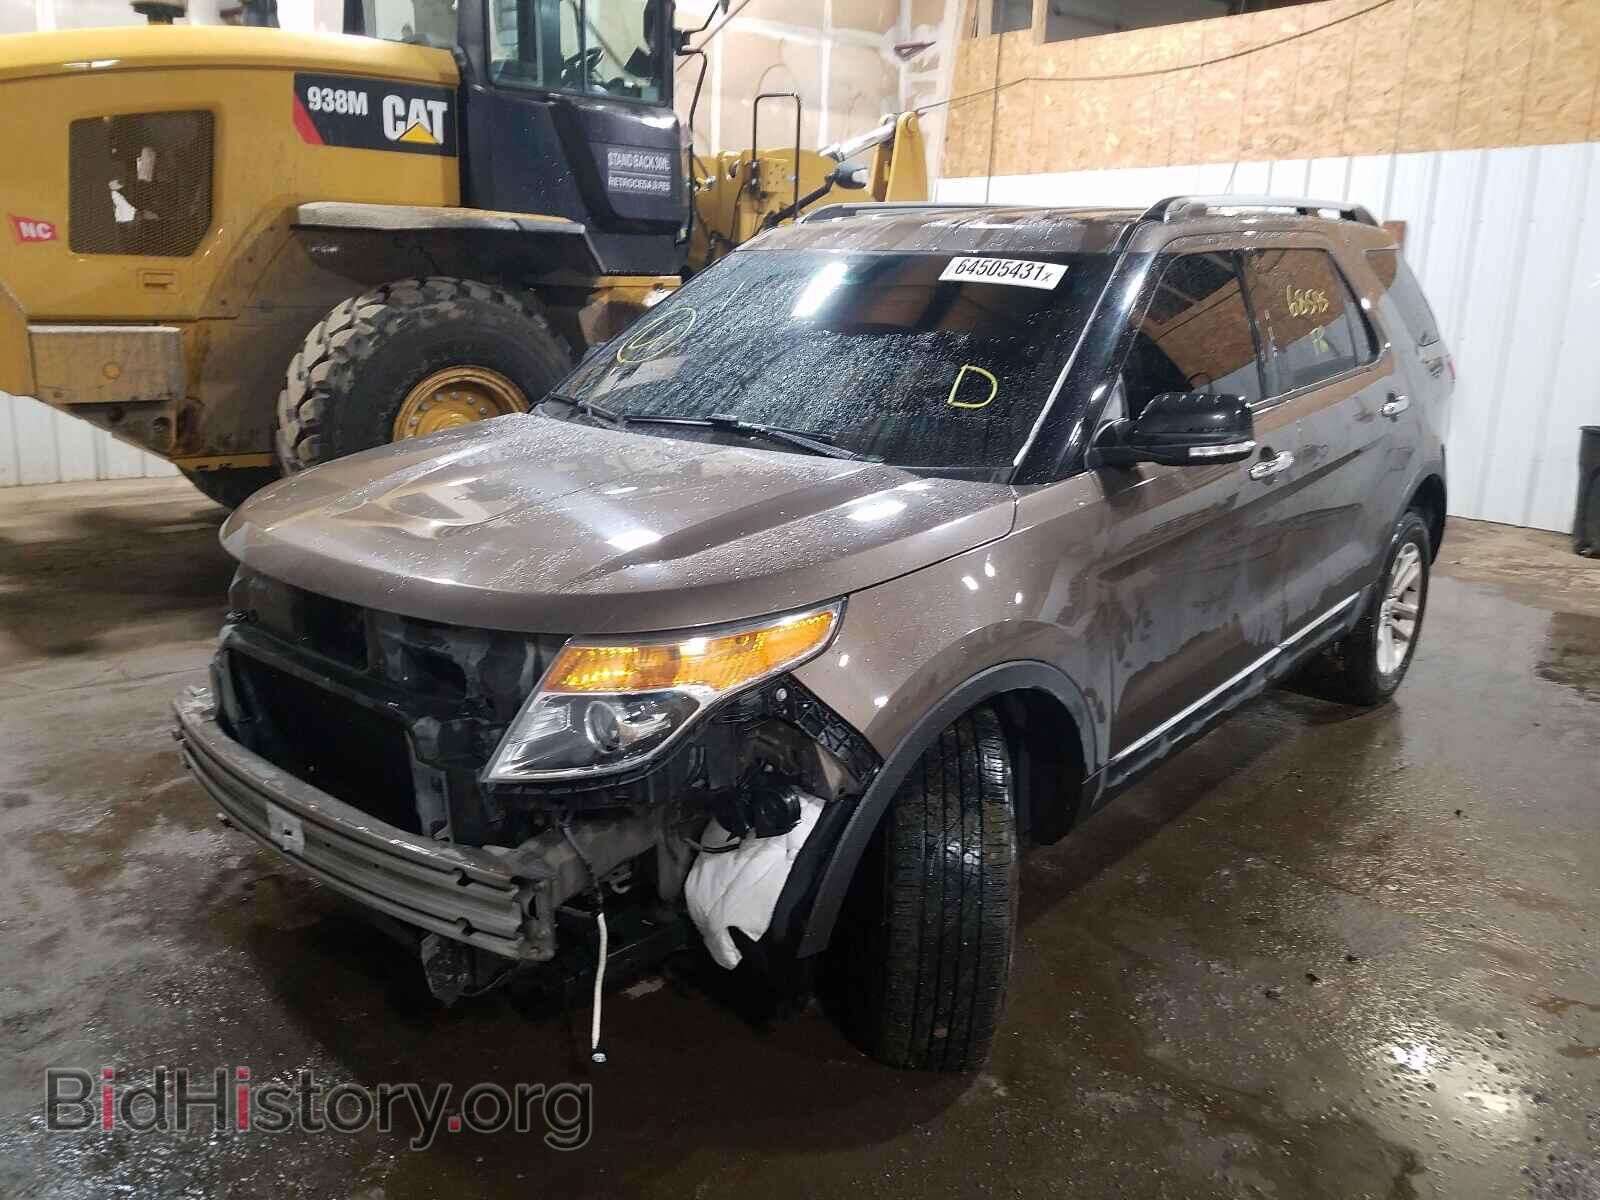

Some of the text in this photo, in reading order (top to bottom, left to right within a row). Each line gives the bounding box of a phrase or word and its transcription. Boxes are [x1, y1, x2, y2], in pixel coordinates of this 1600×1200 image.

[307, 86, 368, 116] 938M
[382, 94, 448, 145] CAT
[947, 363, 998, 408] D
